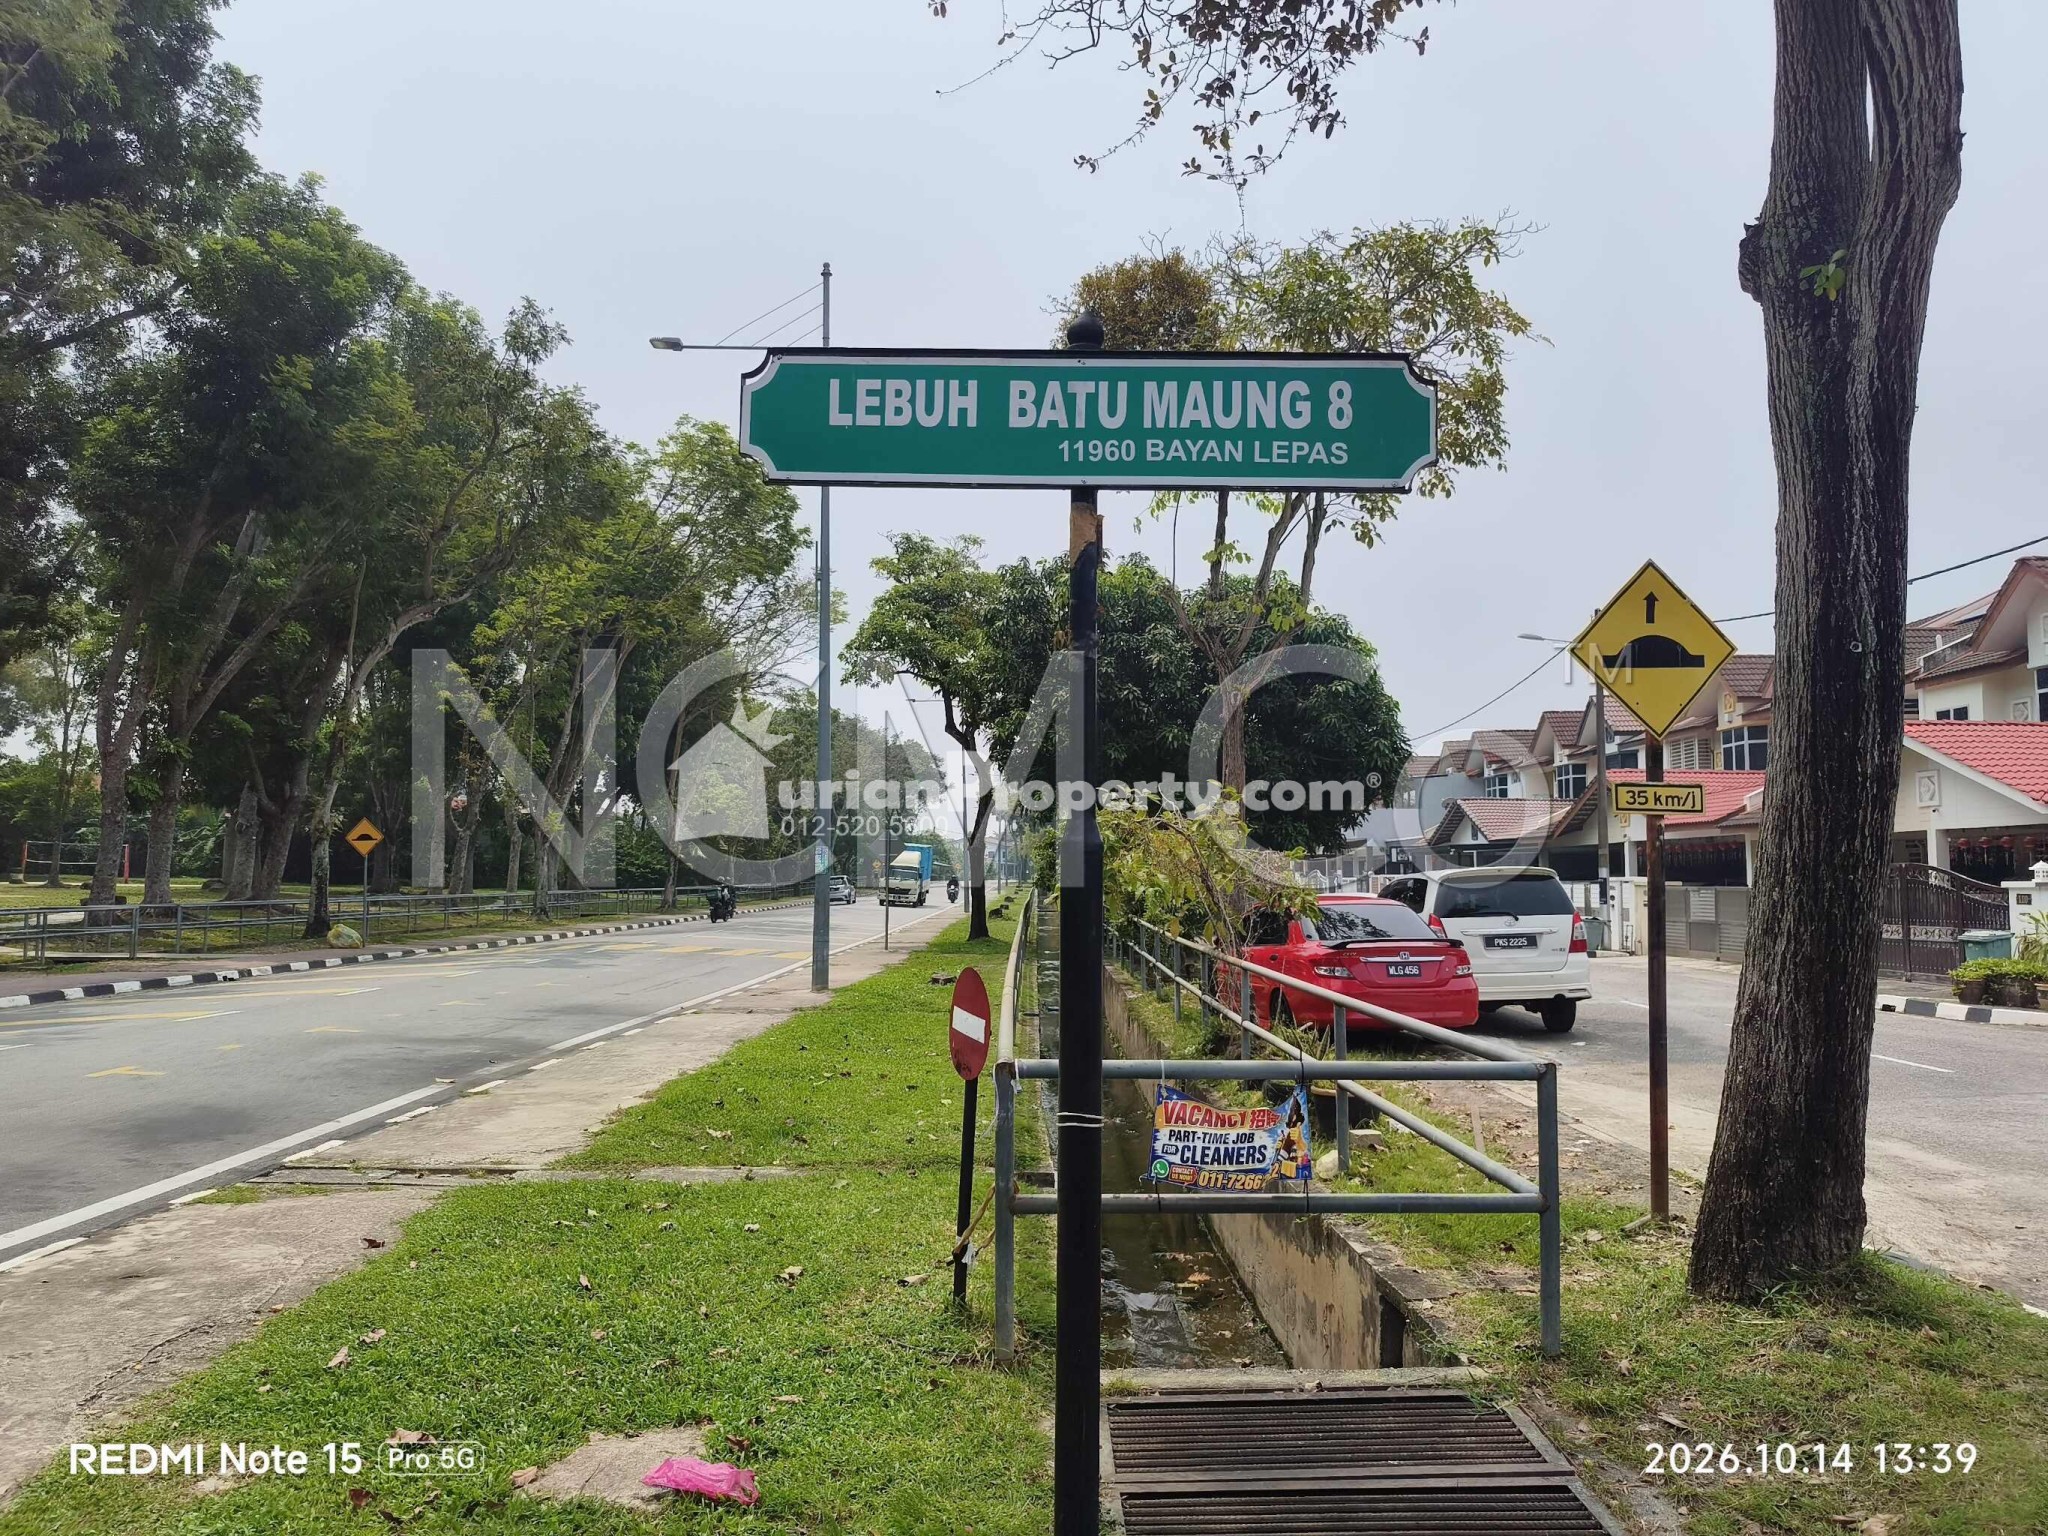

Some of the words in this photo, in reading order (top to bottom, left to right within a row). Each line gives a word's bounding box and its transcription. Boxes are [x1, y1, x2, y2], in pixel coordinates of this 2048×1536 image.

[829, 378, 978, 427] LEBUH
[1008, 380, 1129, 429] BATU
[1143, 380, 1313, 430] MAUNG
[1328, 380, 1353, 430] 8
[1058, 439, 1137, 463] 11960
[1146, 439, 1245, 463] BAYAN
[1253, 441, 1349, 465] LEPAS
[1626, 789, 1649, 806] 35
[1653, 790, 1697, 809] km/j
[1494, 938, 1508, 946] PKS
[1509, 937, 1528, 946] 2225
[1388, 965, 1404, 975] WLG
[1404, 965, 1420, 975] 456
[1163, 1101, 1248, 1128] VACANCY
[1168, 1129, 1230, 1144] PART-TIME
[1232, 1131, 1255, 1145] JOB
[1163, 1145, 1177, 1155] FOR
[1180, 1145, 1267, 1166] CLEANERS
[1171, 1165, 1194, 1175] CONTACT
